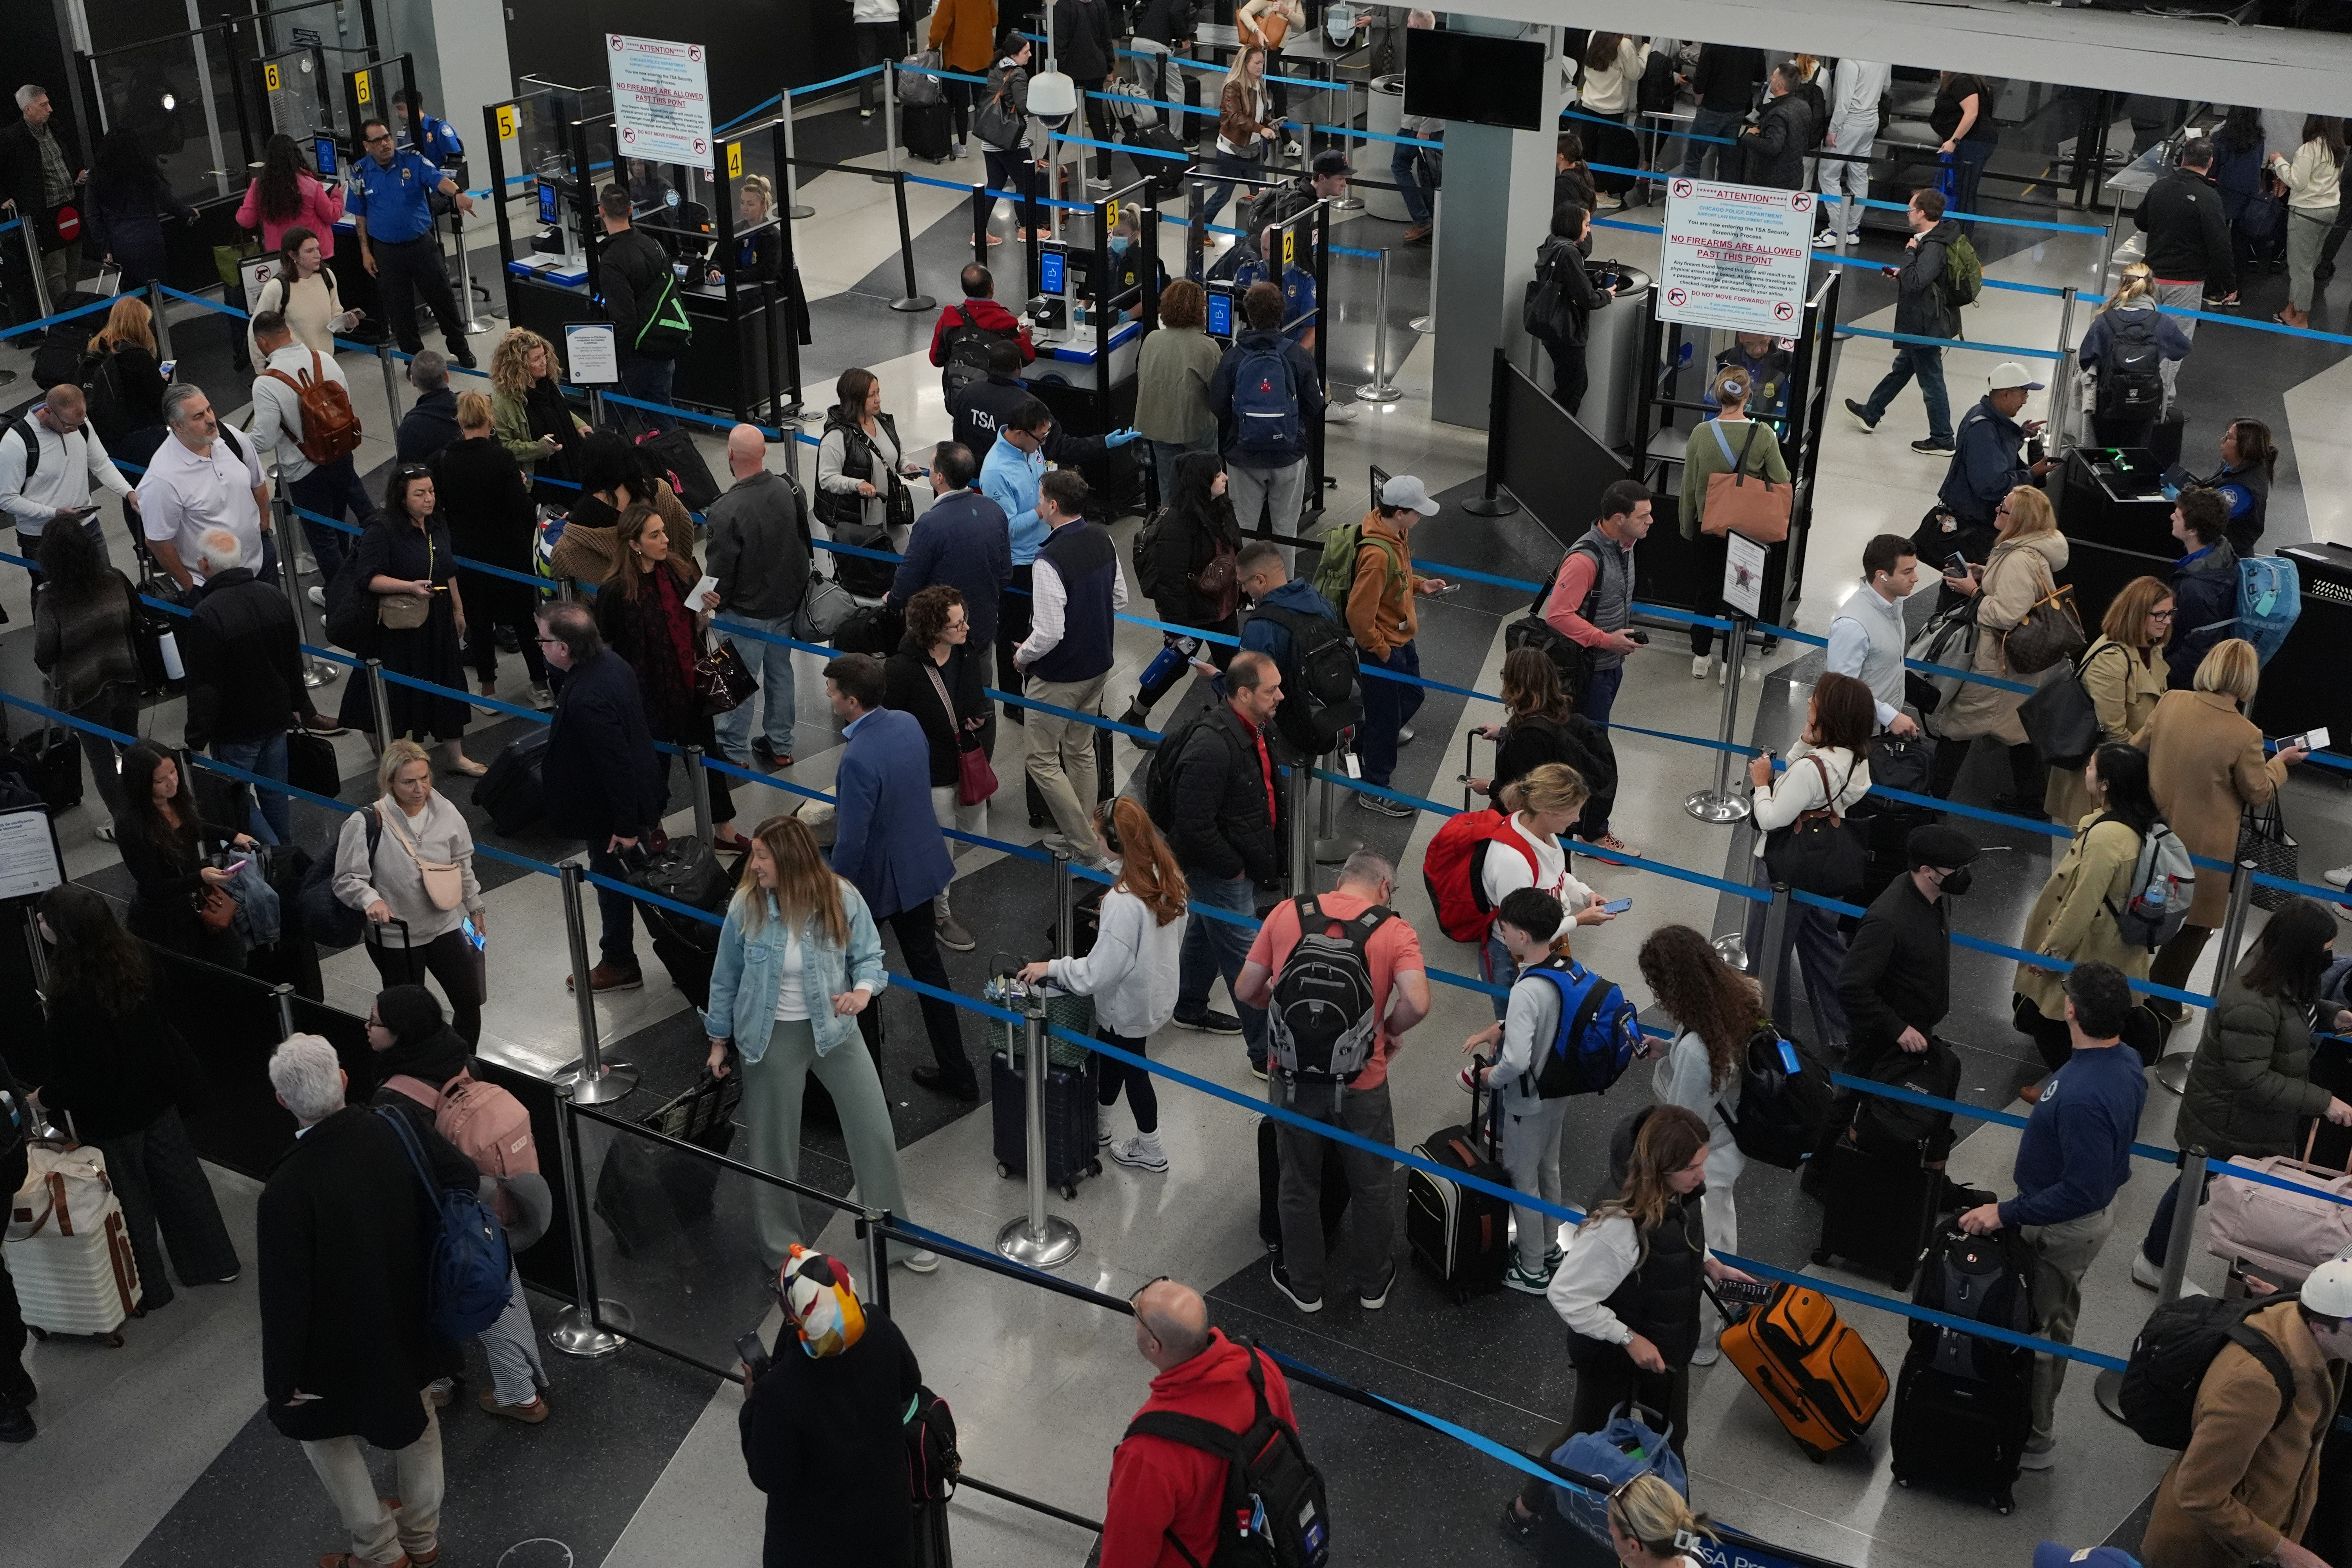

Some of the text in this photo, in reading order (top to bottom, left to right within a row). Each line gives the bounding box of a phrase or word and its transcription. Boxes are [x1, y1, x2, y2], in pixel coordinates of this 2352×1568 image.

[269, 68, 276, 87] 6
[358, 81, 367, 100] 6
[627, 84, 657, 93] FIREARMS
[673, 91, 703, 99] ALLOWED
[501, 116, 512, 136] 5
[731, 154, 739, 174] 4
[1109, 203, 1116, 226] 3
[1712, 229, 1739, 238] Screening
[1285, 236, 1292, 260] 2
[1687, 237, 1732, 248] FIREARMS
[1756, 245, 1801, 256] ALLOWED
[1697, 250, 1772, 264] PAST THIS POINT
[1734, 296, 1770, 304] FORWARD!!!
[971, 408, 996, 432] TSA
[1698, 1546, 1728, 1568] SA
